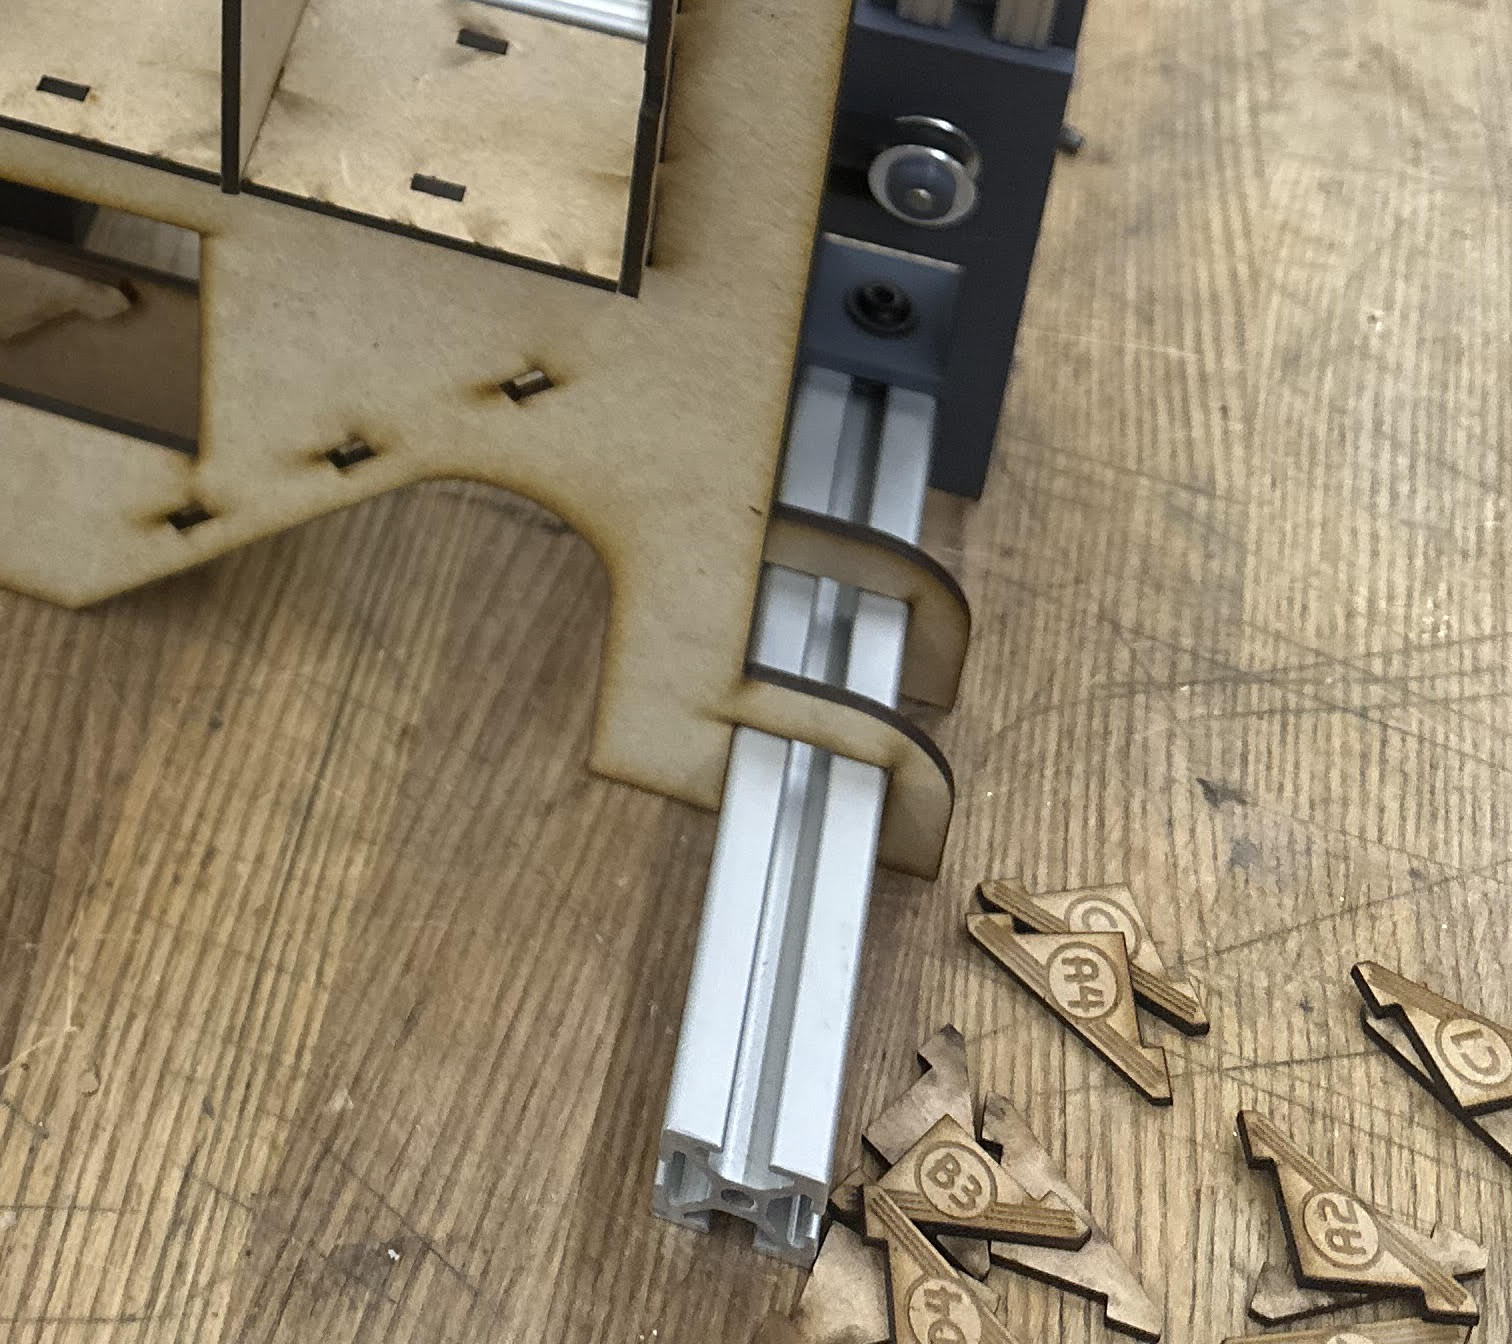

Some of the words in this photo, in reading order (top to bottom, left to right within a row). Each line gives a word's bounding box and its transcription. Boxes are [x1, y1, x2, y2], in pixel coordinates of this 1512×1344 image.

[1061, 955, 1105, 1013] A4
[925, 1152, 983, 1211] B3
[1317, 1197, 1367, 1256] A2
